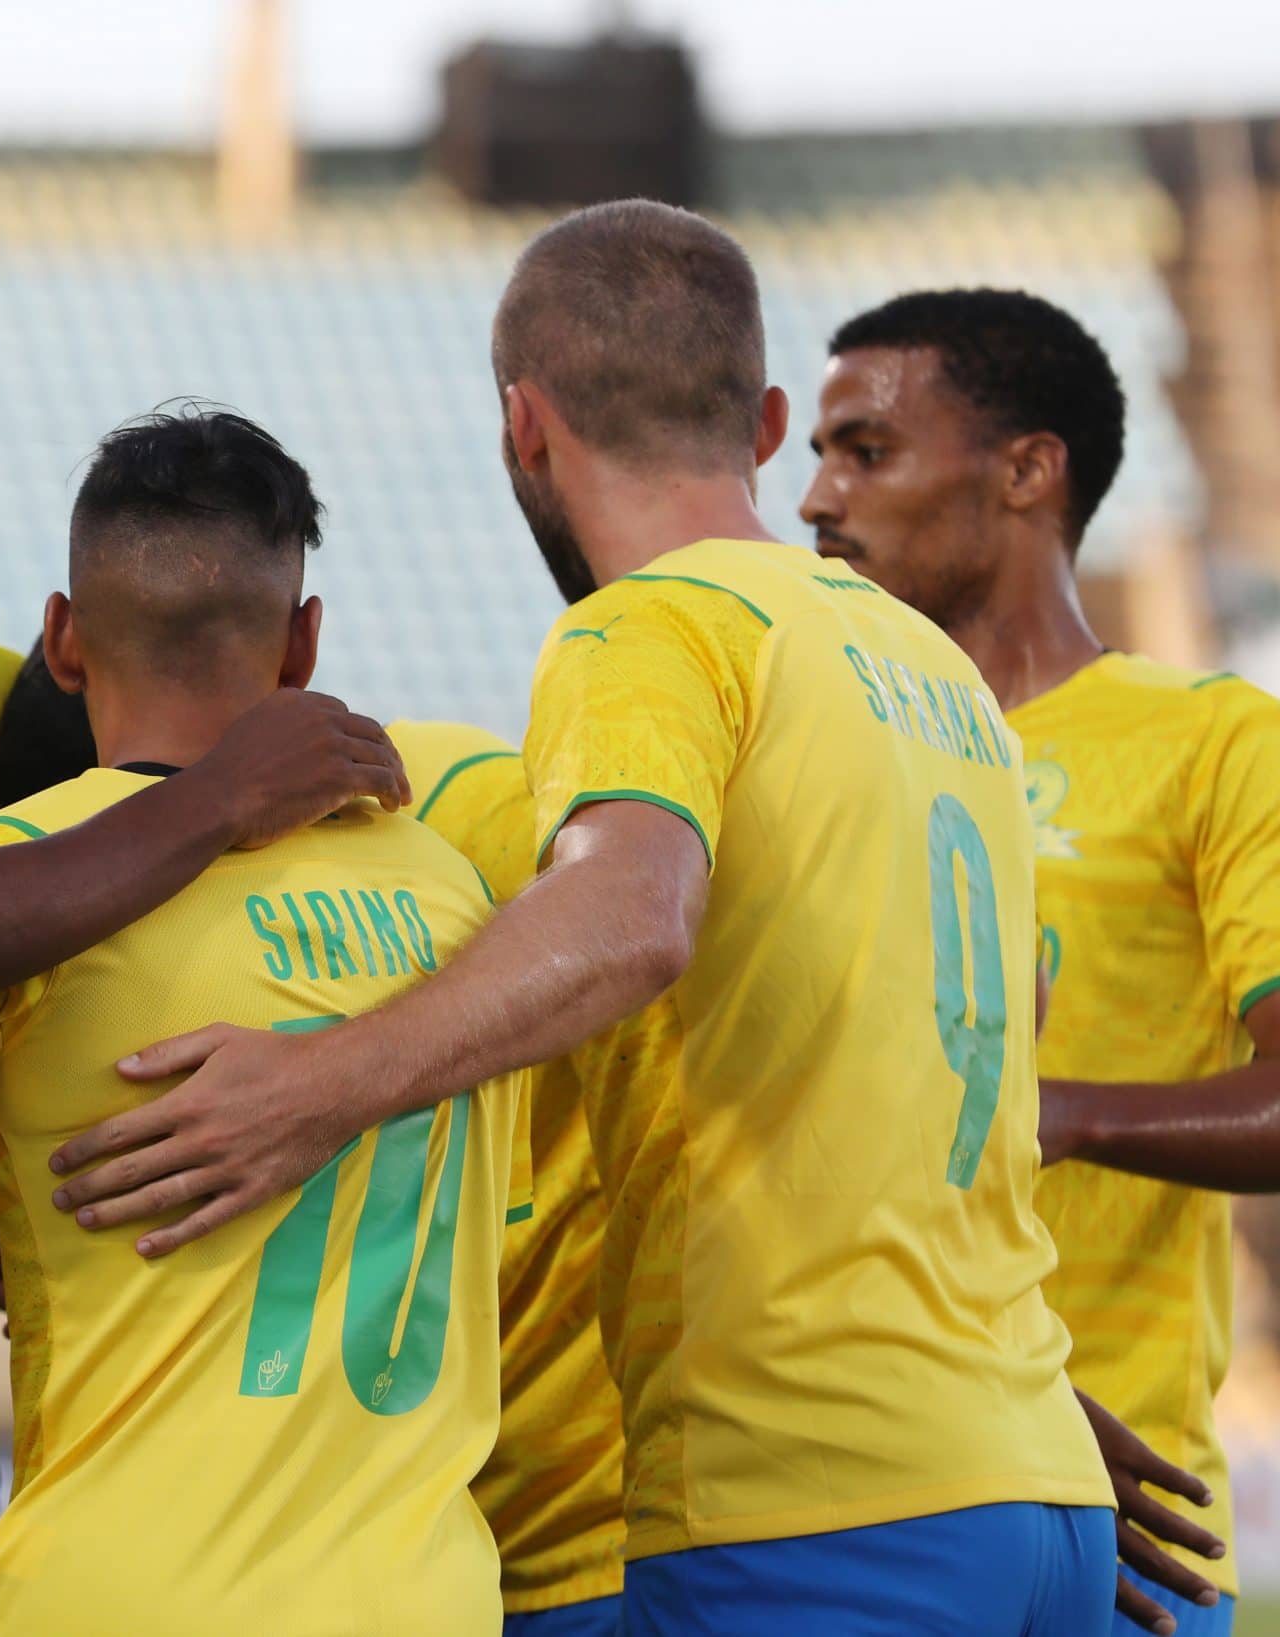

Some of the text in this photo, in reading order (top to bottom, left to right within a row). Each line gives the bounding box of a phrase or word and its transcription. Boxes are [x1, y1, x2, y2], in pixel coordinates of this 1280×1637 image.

[244, 888, 438, 981] SIRINO
[927, 792, 1008, 1191] 9
[237, 1013, 472, 1417] 10
